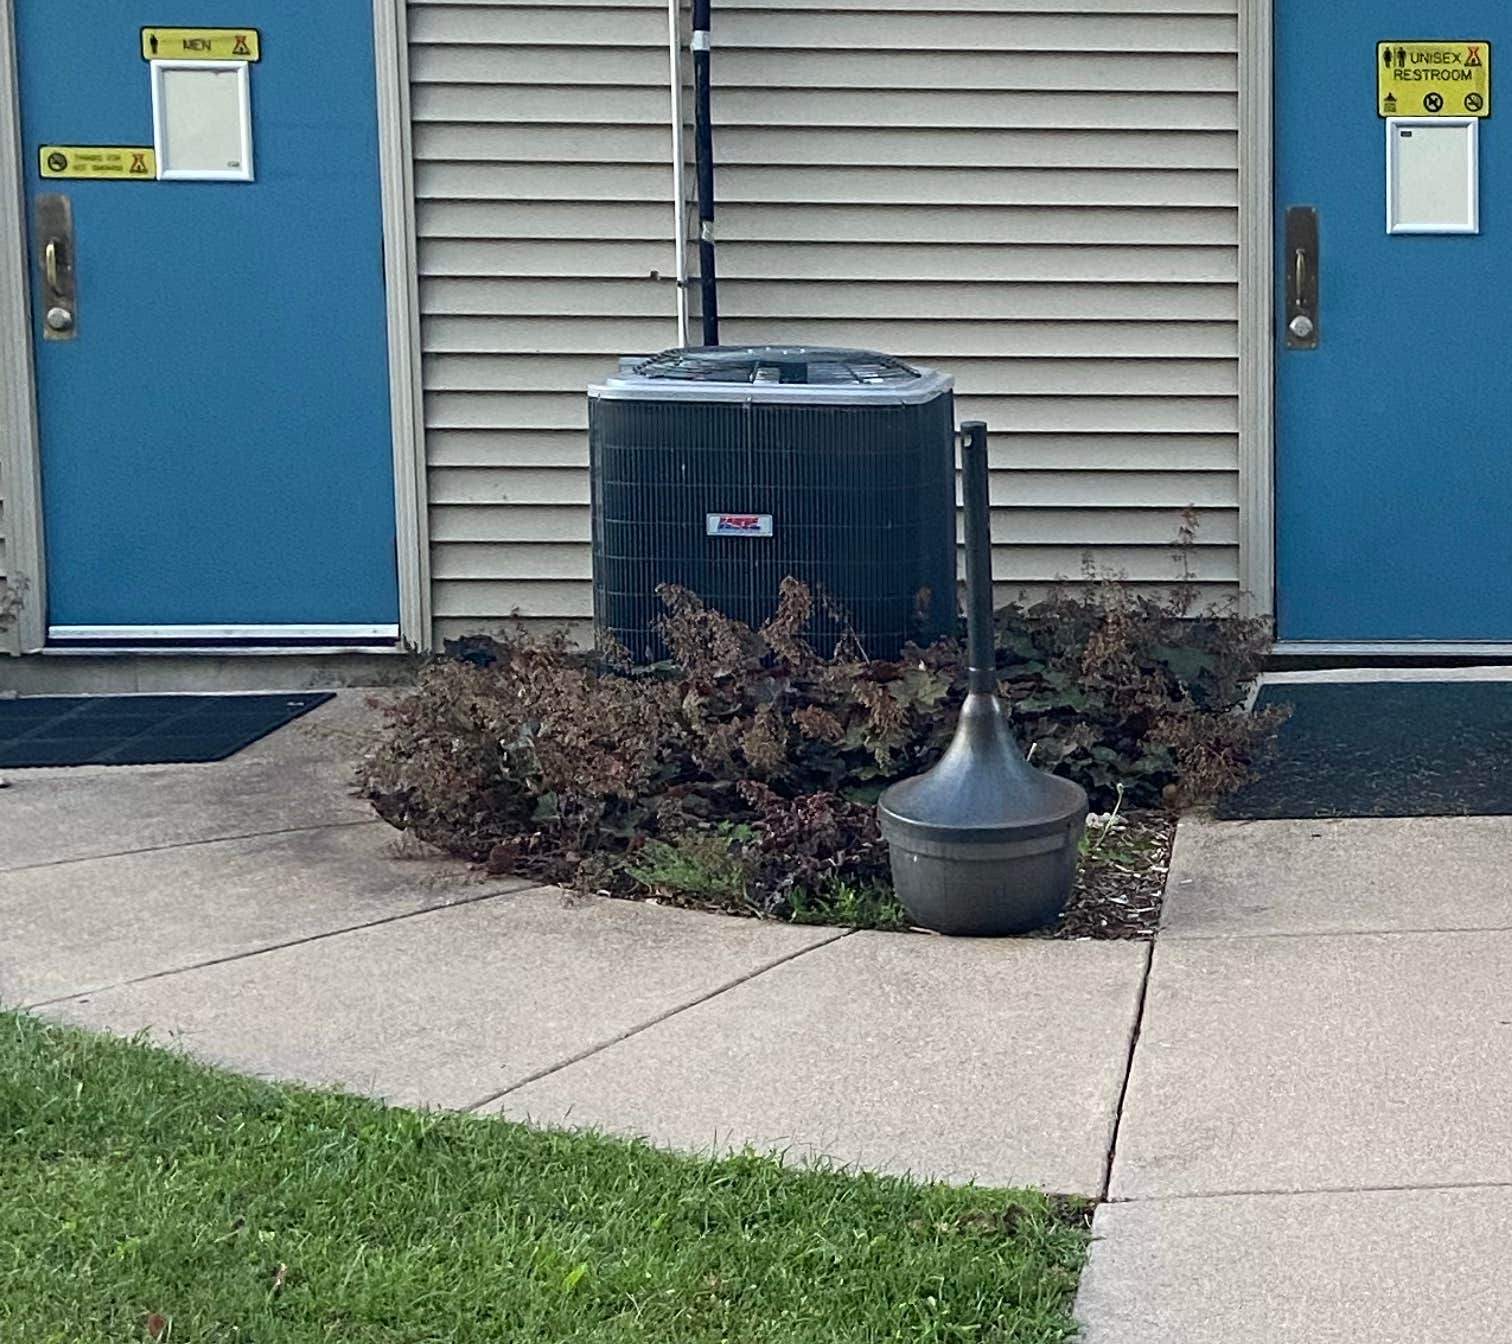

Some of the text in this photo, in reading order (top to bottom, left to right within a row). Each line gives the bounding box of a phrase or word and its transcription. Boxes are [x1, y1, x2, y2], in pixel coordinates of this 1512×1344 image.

[183, 39, 212, 52] MEN
[1410, 51, 1462, 65] UNISEX
[1393, 69, 1473, 81] RESTROOM
